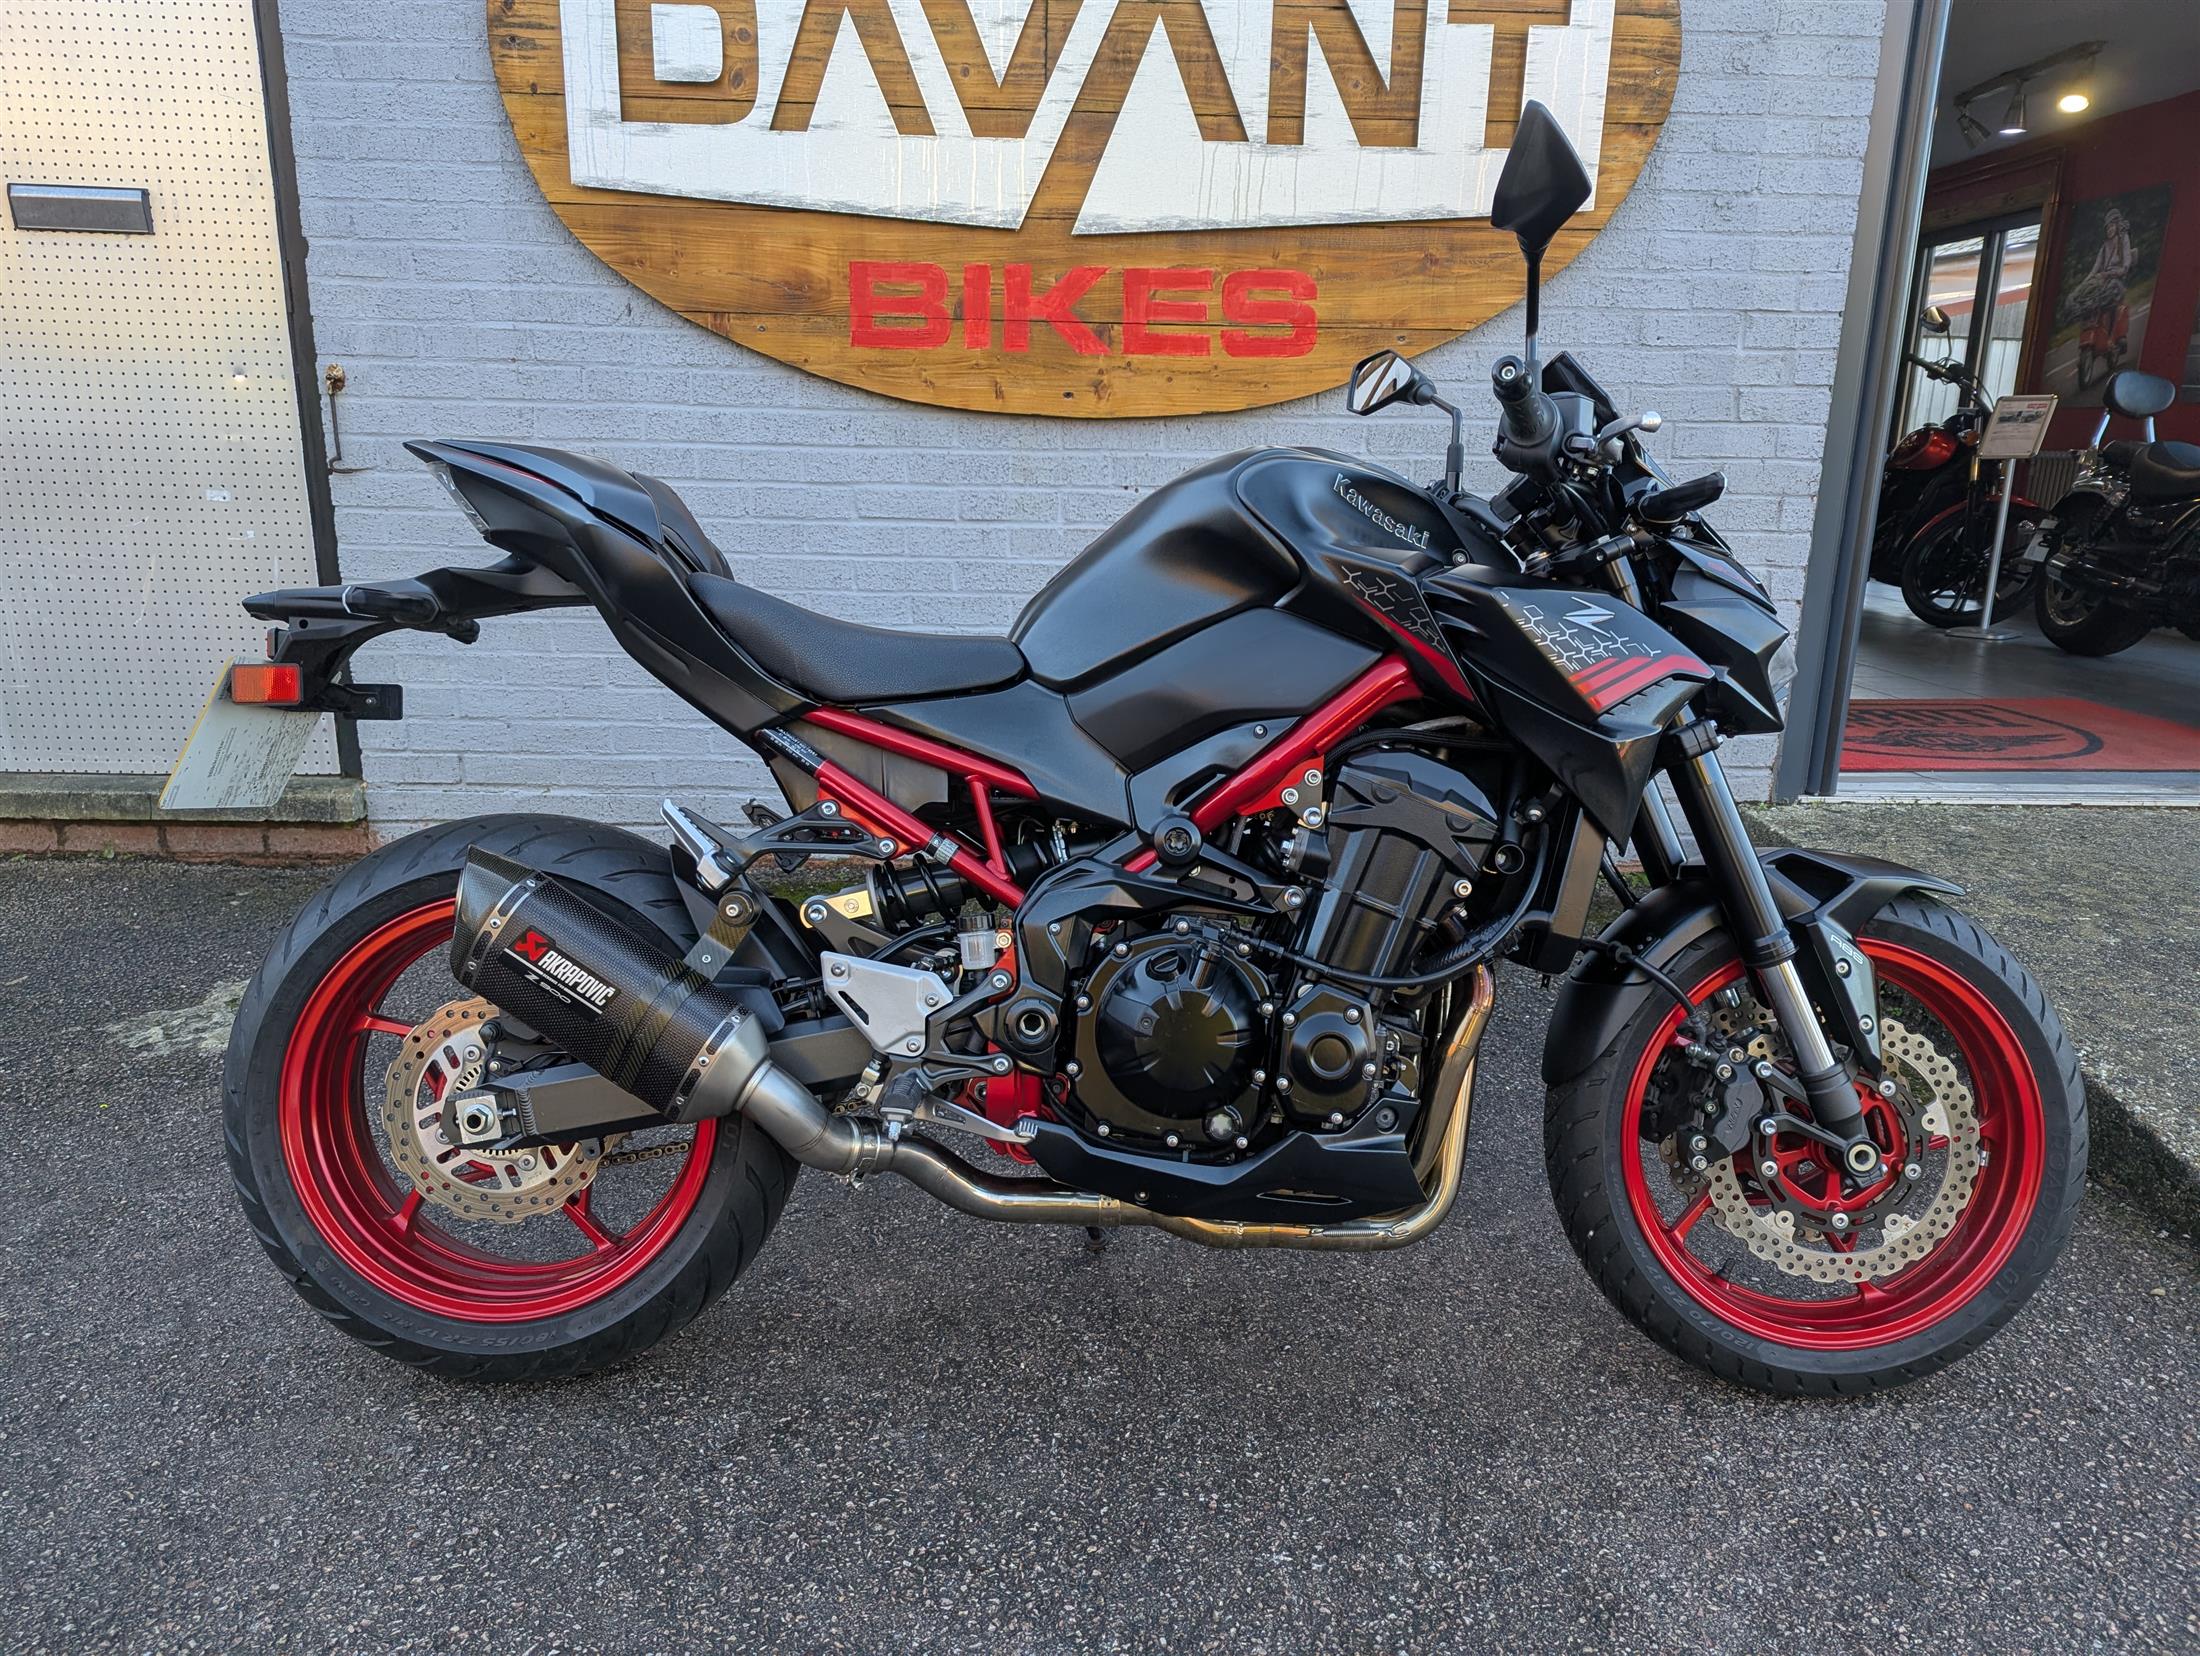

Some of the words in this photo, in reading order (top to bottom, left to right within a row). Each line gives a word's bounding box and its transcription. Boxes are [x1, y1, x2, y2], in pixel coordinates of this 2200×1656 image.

[613, 0, 1571, 150] DAVANT
[849, 260, 1318, 358] BIKES
[1333, 472, 1431, 549] Kawasaki
[1830, 934, 1864, 965] ABS
[1688, 1309, 1754, 1350] 120/70
